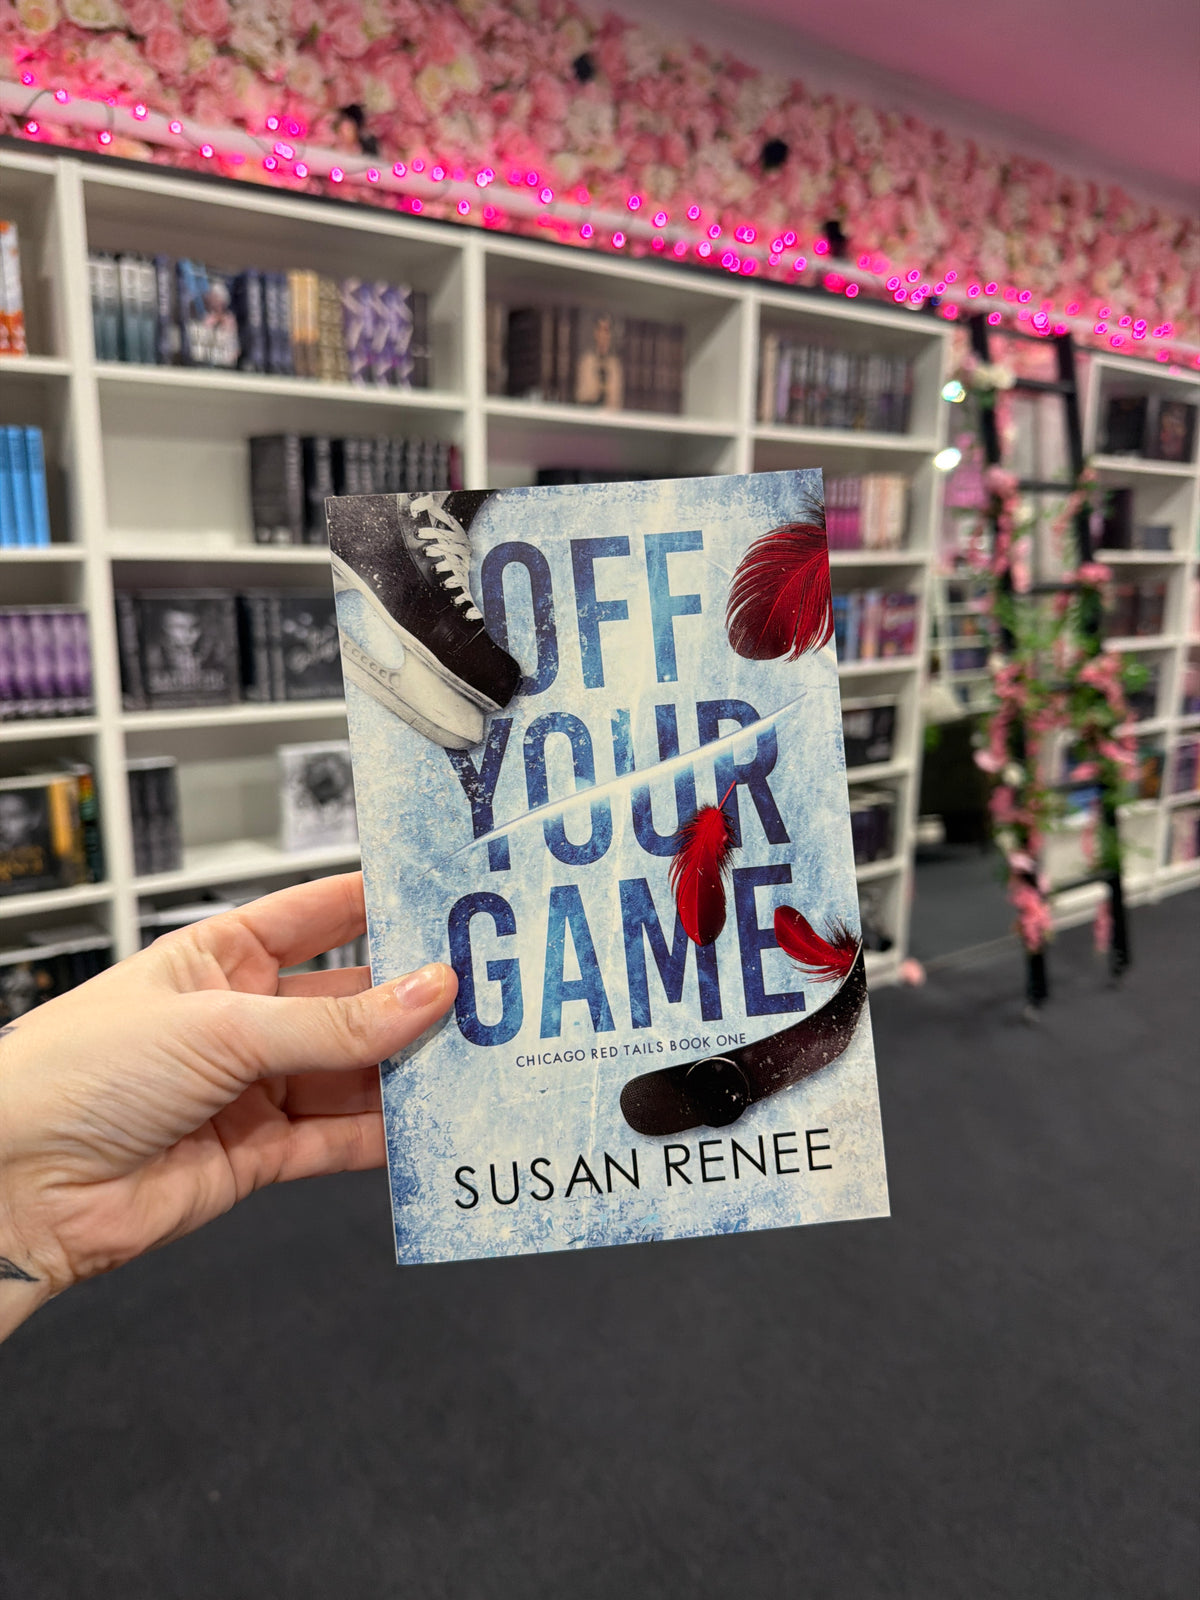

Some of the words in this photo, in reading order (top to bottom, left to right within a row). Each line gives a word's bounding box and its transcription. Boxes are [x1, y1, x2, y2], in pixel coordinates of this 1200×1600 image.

[481, 530, 704, 696] OFF
[444, 699, 791, 872] YOUR
[447, 864, 806, 1047] GAME
[516, 1049, 586, 1067] CHICAGO
[591, 1046, 618, 1060] RED
[624, 1041, 664, 1057] TAILS
[670, 1036, 711, 1052] BOOK
[716, 1032, 747, 1047] ONE
[454, 1148, 640, 1210] SUSAN
[664, 1128, 833, 1187] RENEE
